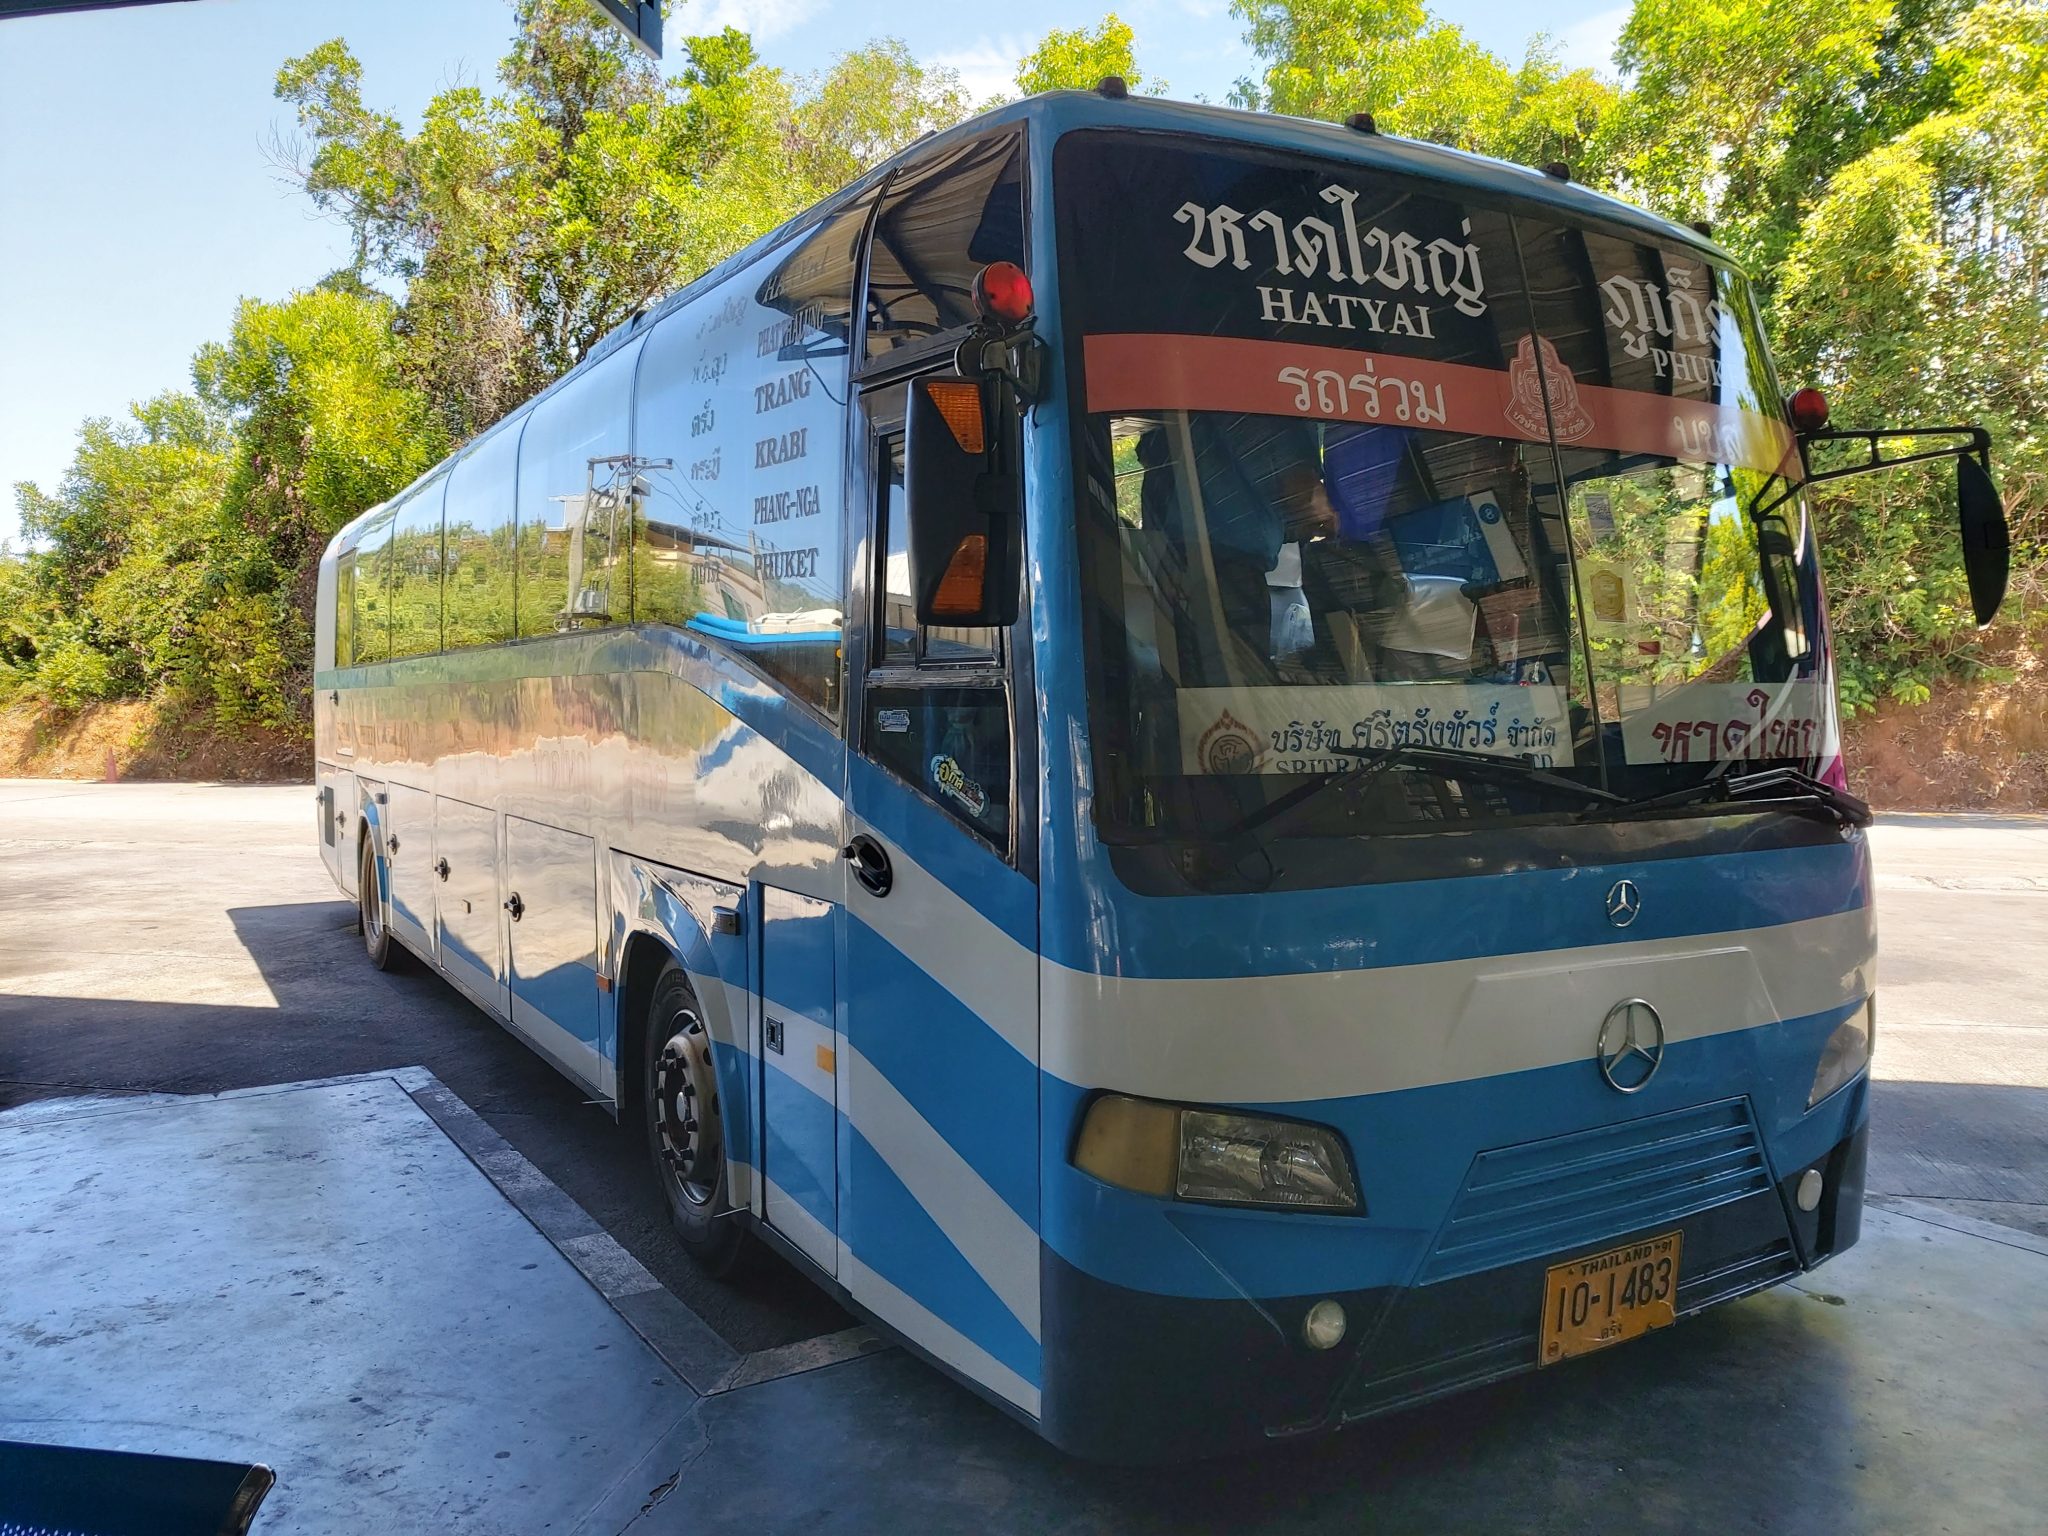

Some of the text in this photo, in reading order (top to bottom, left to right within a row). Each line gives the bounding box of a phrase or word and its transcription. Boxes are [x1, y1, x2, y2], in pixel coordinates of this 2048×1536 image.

[1172, 184, 1488, 317] หาดใหญ่
[1256, 286, 1436, 339] HATYAI
[755, 367, 811, 415] TRANG
[1278, 358, 1447, 425] รถร่วม
[1650, 347, 1728, 388] PHUK
[755, 427, 808, 469] KRABI
[754, 485, 820, 525] PHANG-NGA
[753, 547, 819, 581] PHUKET
[1271, 702, 1556, 753] บริษัท ศรีตรังทัวร์ จำกัด
[1581, 1246, 1652, 1276] THAILAND
[1557, 1256, 1672, 1333] 10-1483
